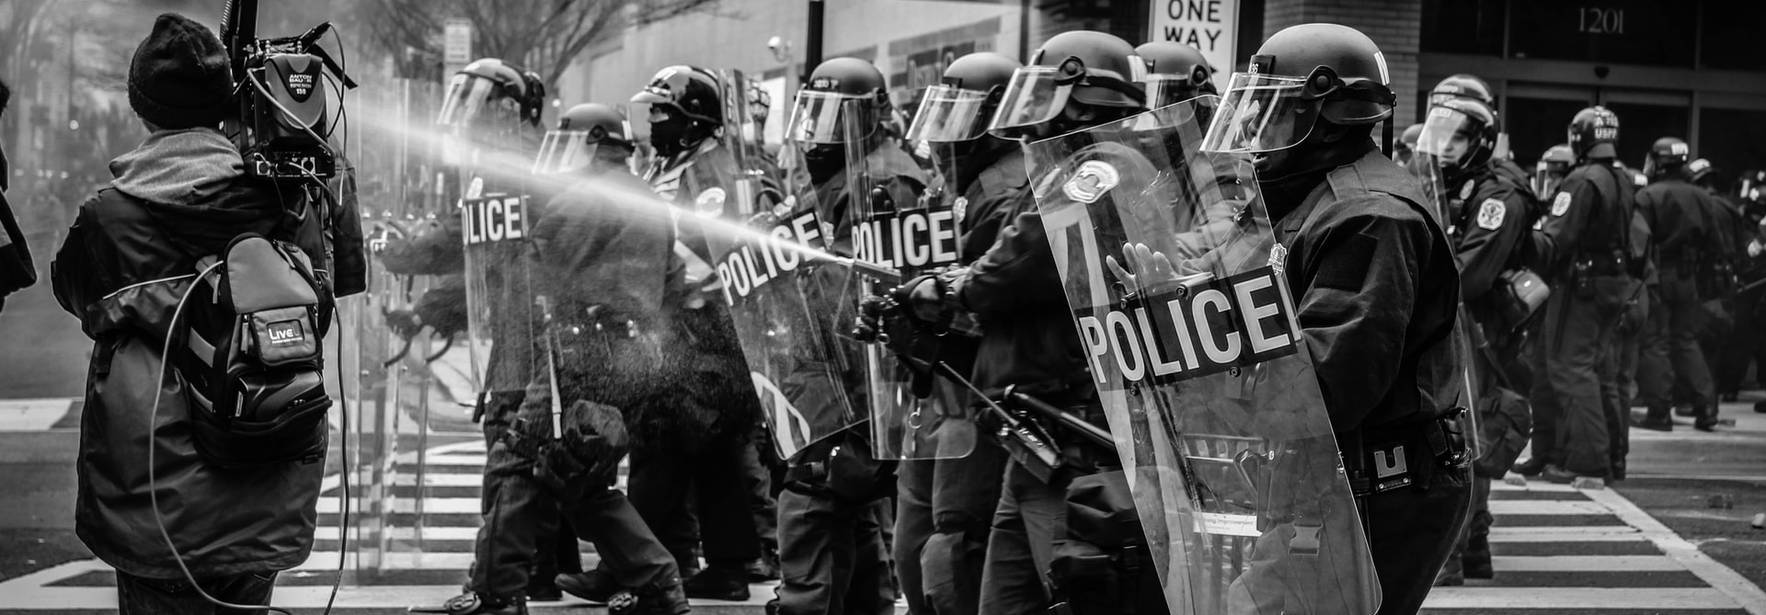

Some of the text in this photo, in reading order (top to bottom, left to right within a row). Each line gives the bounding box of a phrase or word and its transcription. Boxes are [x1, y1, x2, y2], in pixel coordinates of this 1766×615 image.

[1168, 0, 1221, 22] ONE
[1580, 8, 1623, 34] 1201
[1165, 26, 1222, 51] WAY
[461, 197, 521, 245] OLICE
[851, 210, 957, 268] POLICE
[719, 212, 826, 306] POLICE
[1079, 275, 1291, 384] POLICE
